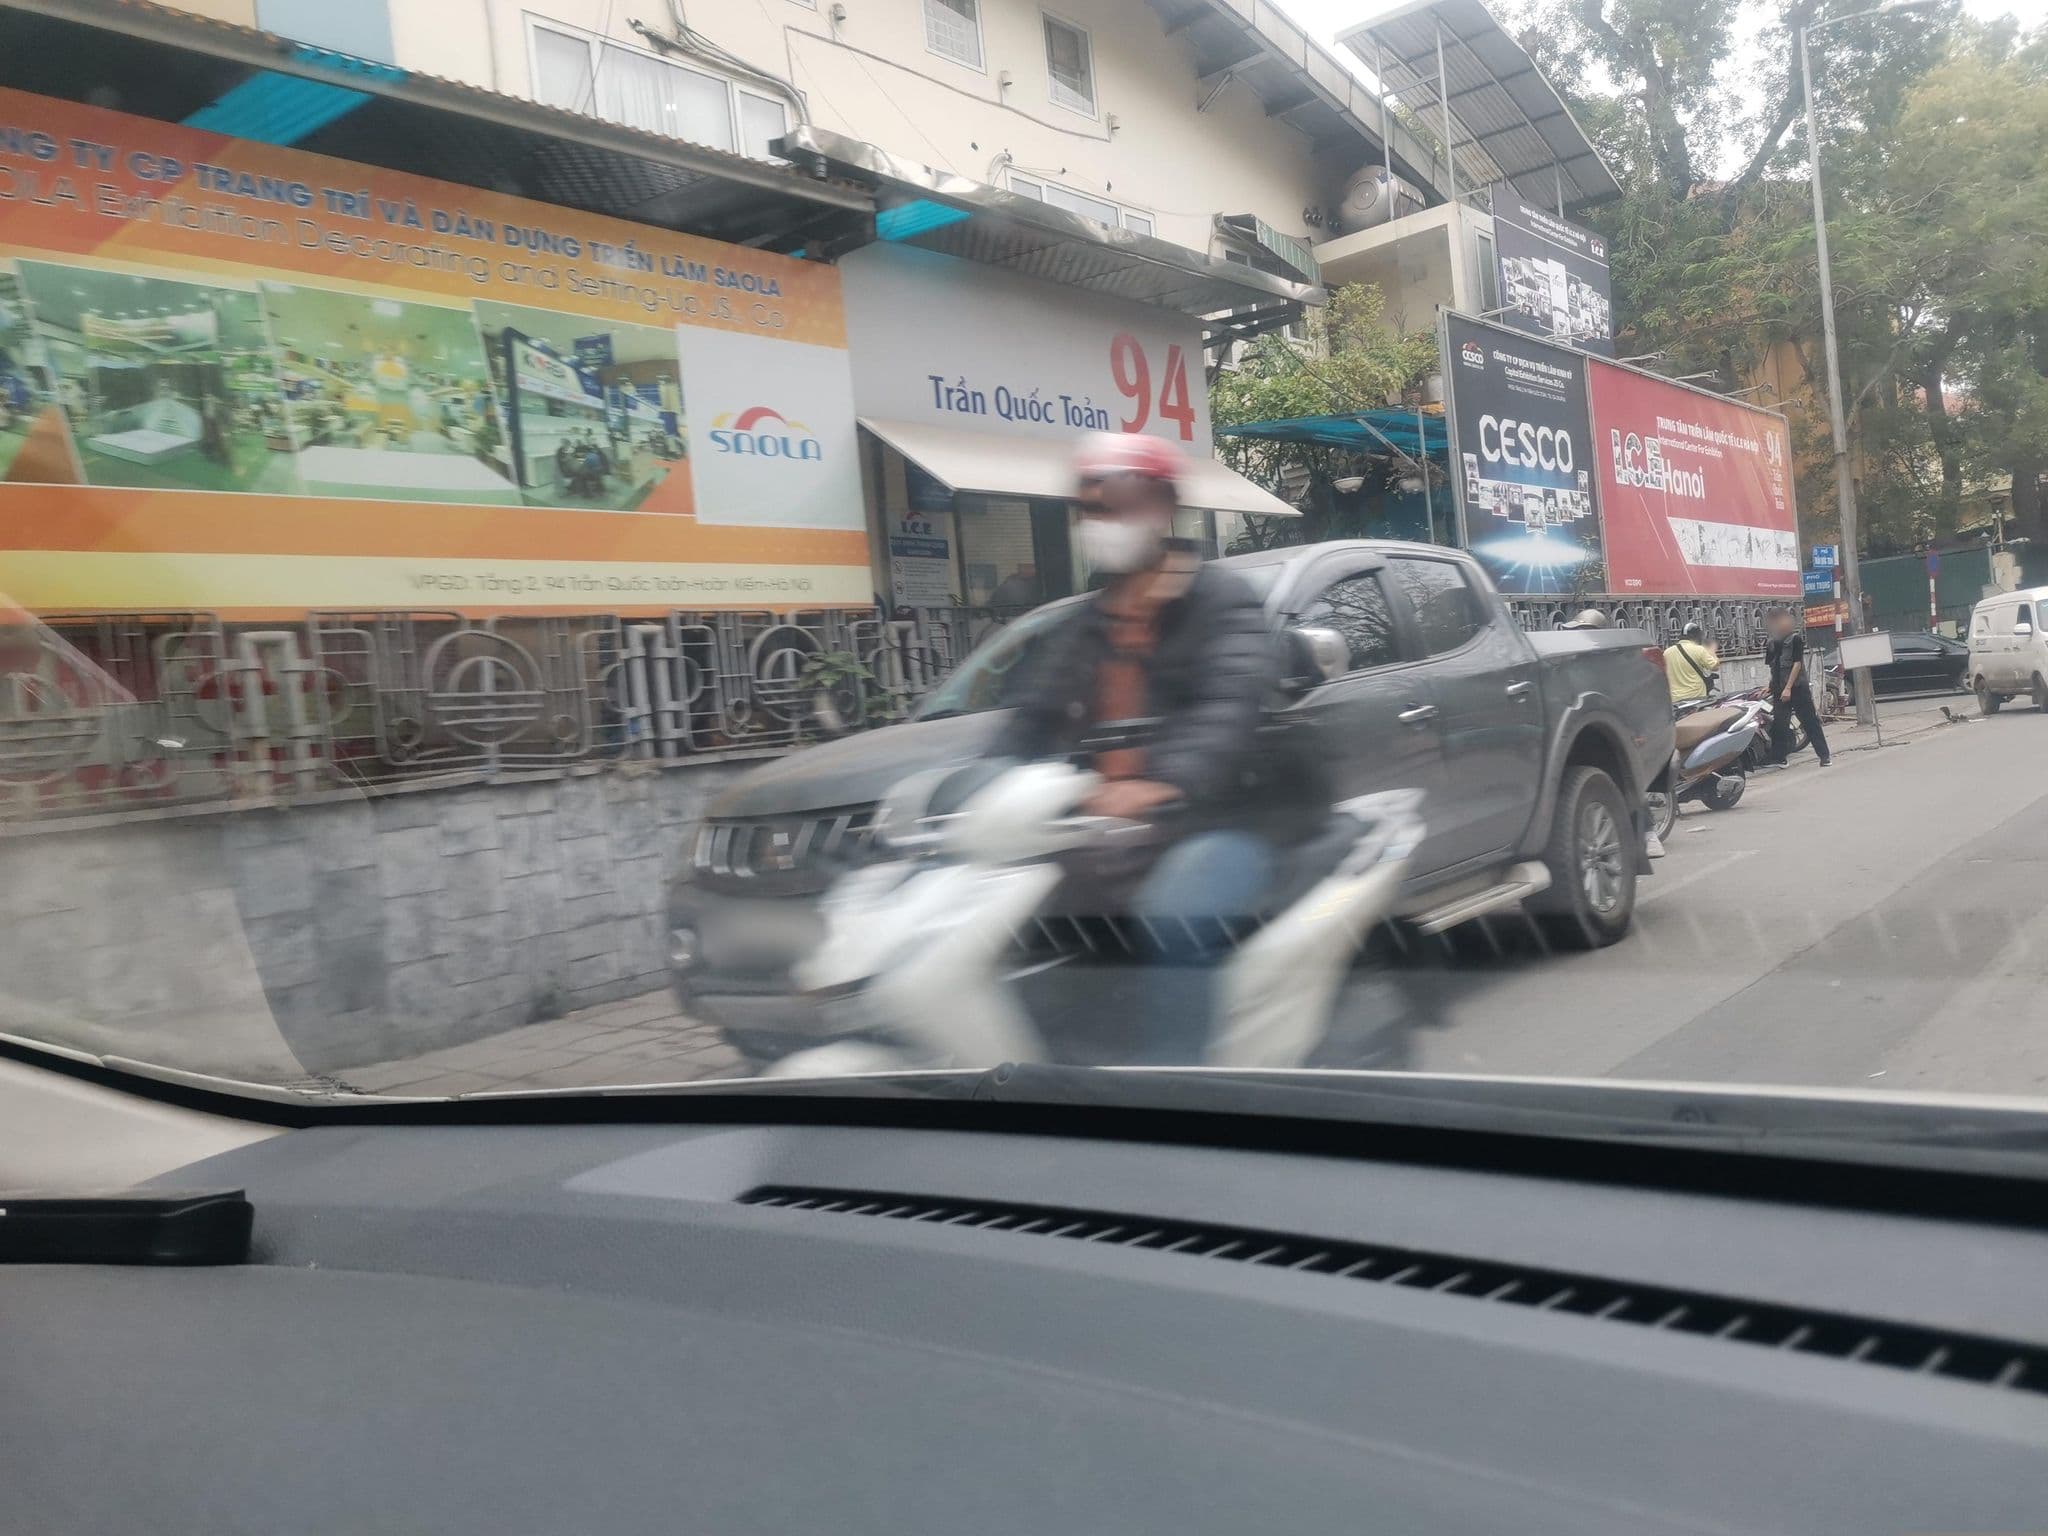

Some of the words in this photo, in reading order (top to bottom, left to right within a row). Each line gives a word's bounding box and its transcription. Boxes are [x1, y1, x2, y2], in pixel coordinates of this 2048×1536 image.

[68, 138, 116, 172] TY
[128, 152, 183, 183] CP
[193, 162, 313, 208] TRANG
[321, 187, 370, 219] TRÍ
[377, 197, 424, 230] VÀ
[503, 223, 581, 258] DỰNG
[715, 267, 782, 297] SAOLA
[97, 182, 290, 244] Exhibition
[297, 219, 489, 283] Decorating
[499, 258, 558, 288] and
[928, 375, 987, 415] Trần
[994, 386, 1055, 424] Quốc
[1059, 395, 1109, 430] Toản
[1110, 330, 1196, 441] 94
[710, 429, 821, 461] SAOLA
[1479, 414, 1573, 473] CESCO
[1766, 430, 1782, 466] 94
[1663, 458, 1705, 499] Hanoi
